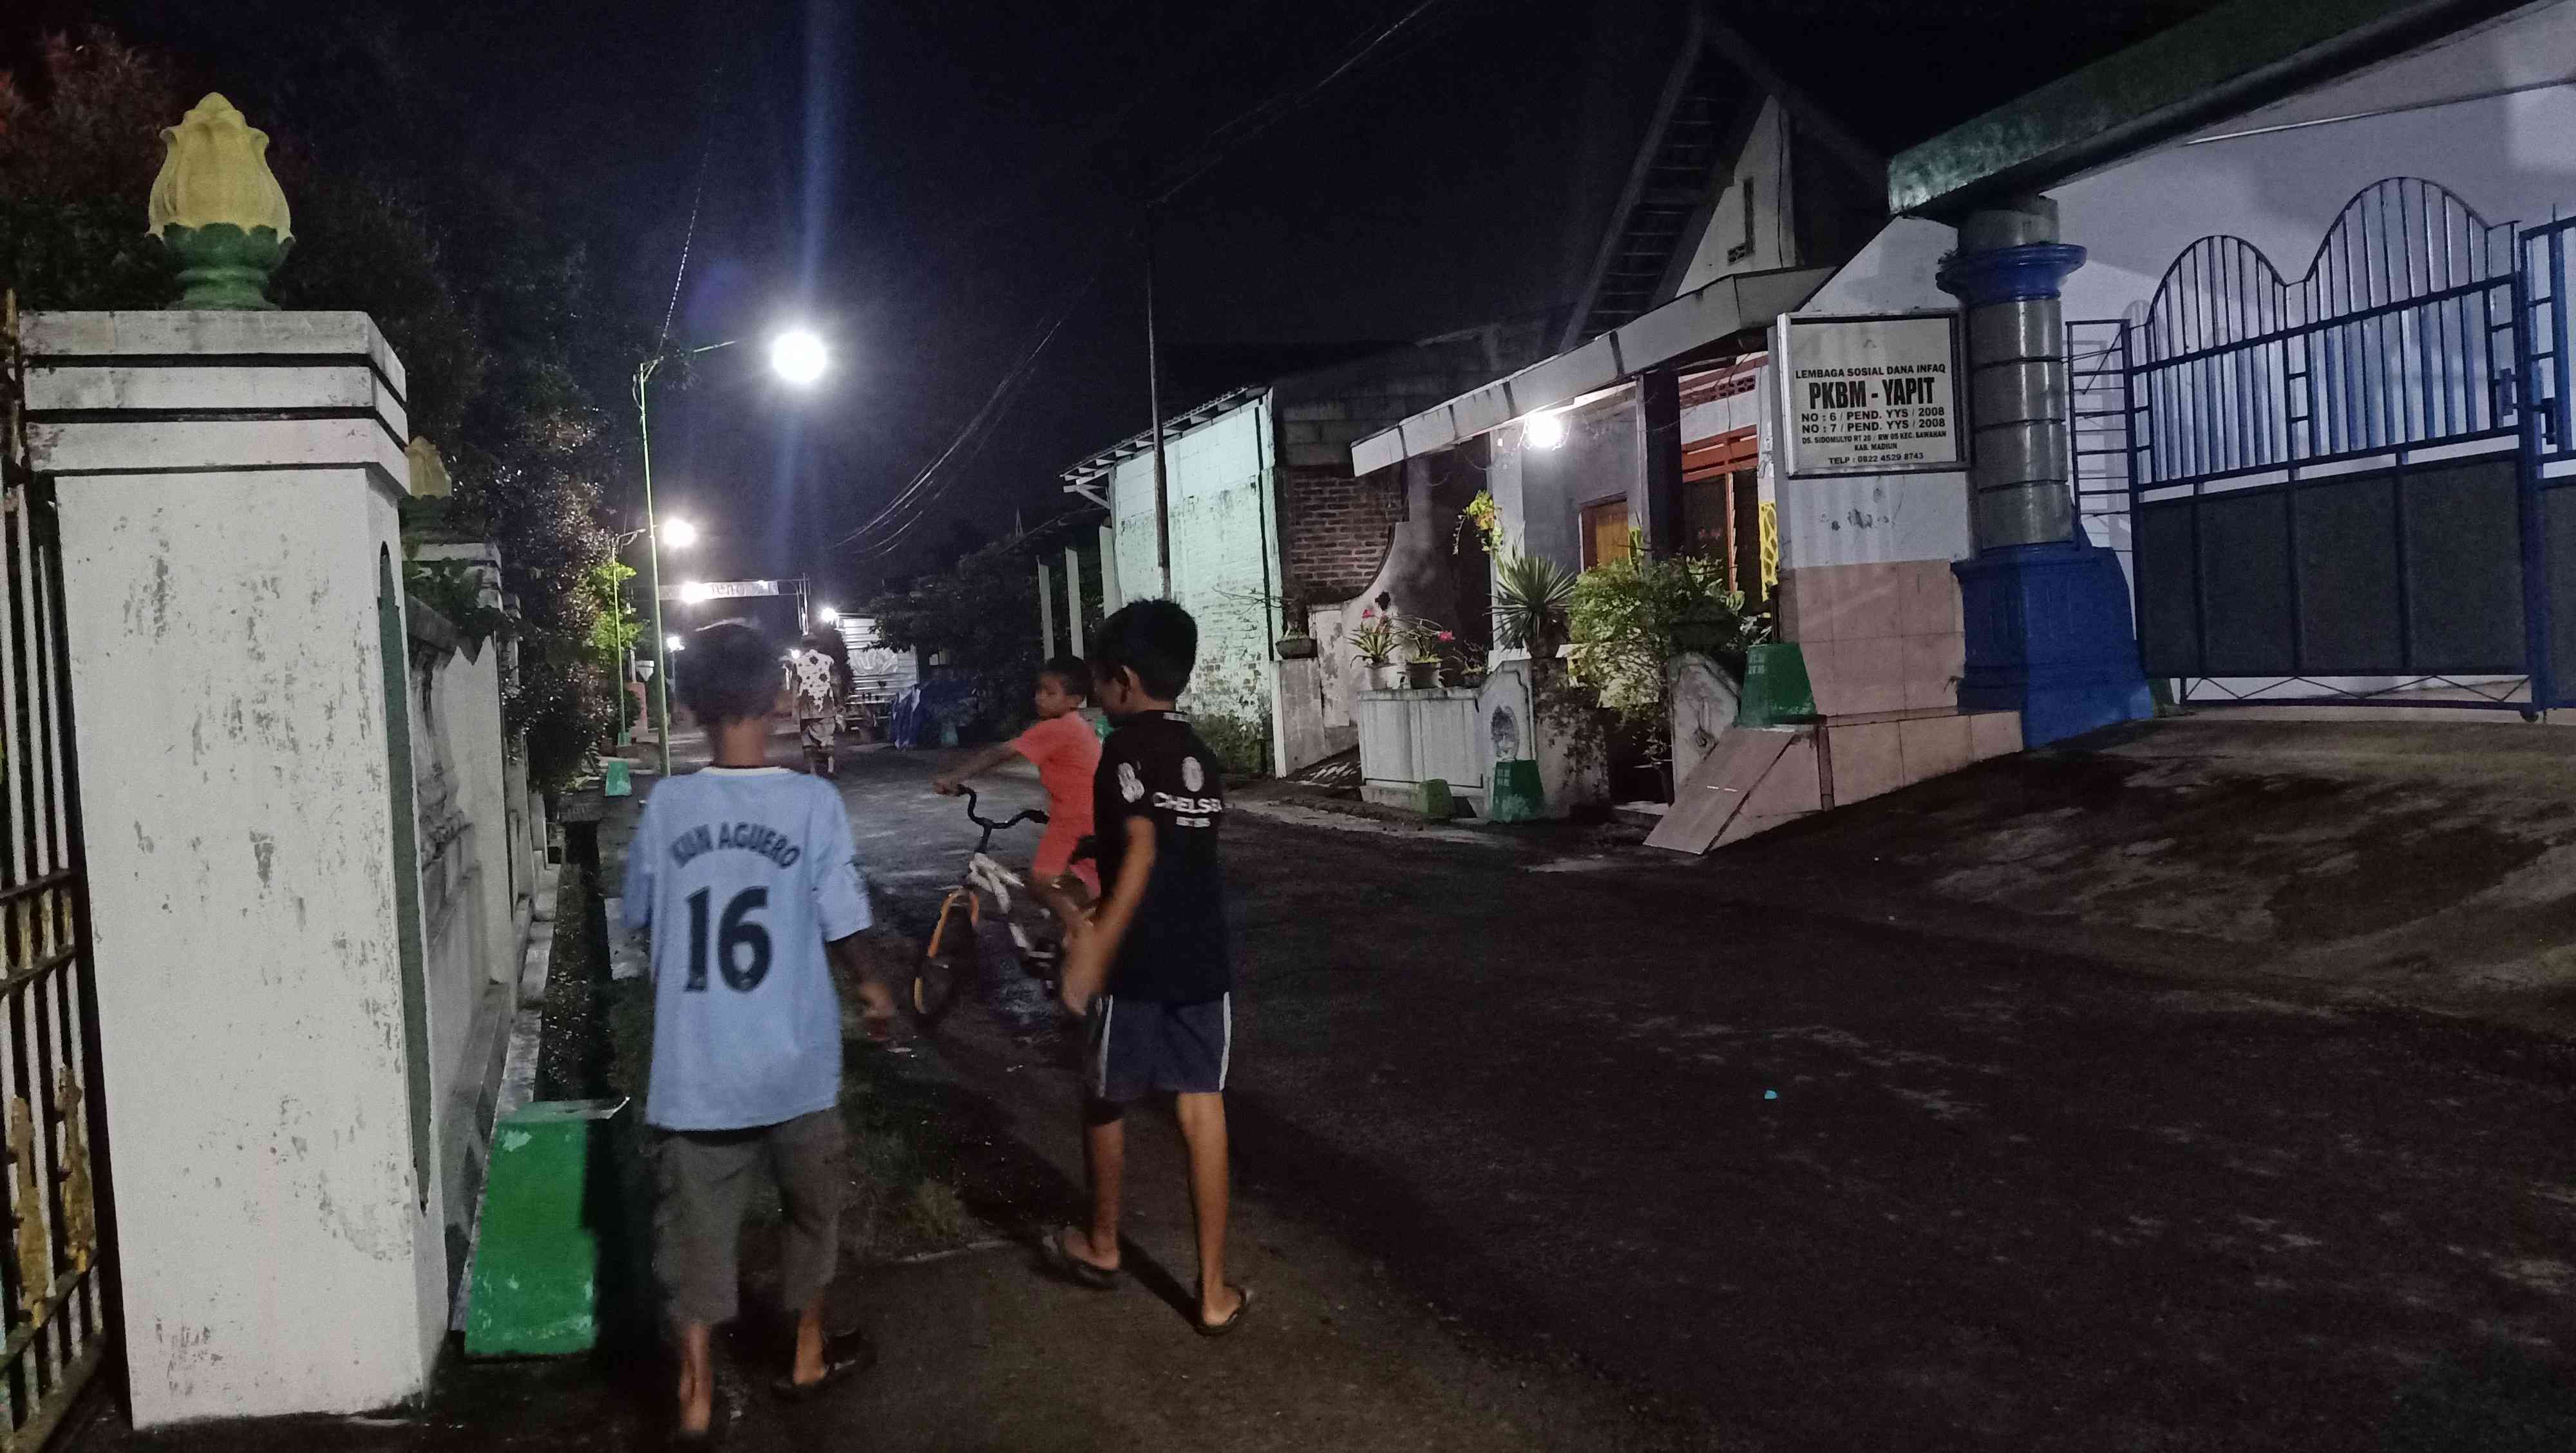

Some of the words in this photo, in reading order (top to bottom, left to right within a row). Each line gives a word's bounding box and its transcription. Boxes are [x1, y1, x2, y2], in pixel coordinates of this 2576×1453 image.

[1795, 368, 1844, 379] LEMBAGA
[1847, 367, 1884, 377] SOSIAL
[1886, 365, 1914, 375] DANA
[1917, 364, 1946, 374] INFAQ
[1809, 381, 1866, 410] PKBM
[1882, 377, 1935, 406] YAPIT
[1802, 413, 1819, 423] NO
[1830, 412, 1837, 421] 6
[1847, 410, 1882, 421] PEND.
[1886, 408, 1909, 419] YYS
[1918, 406, 1945, 417] 2008
[1802, 424, 1819, 433] NO
[1830, 424, 1837, 433] 7
[1847, 422, 1882, 432] PEND.
[1886, 420, 1909, 430] YYS
[1918, 418, 1946, 428] 2008
[1880, 453, 1902, 462] 4529
[684, 885, 771, 992] 16
